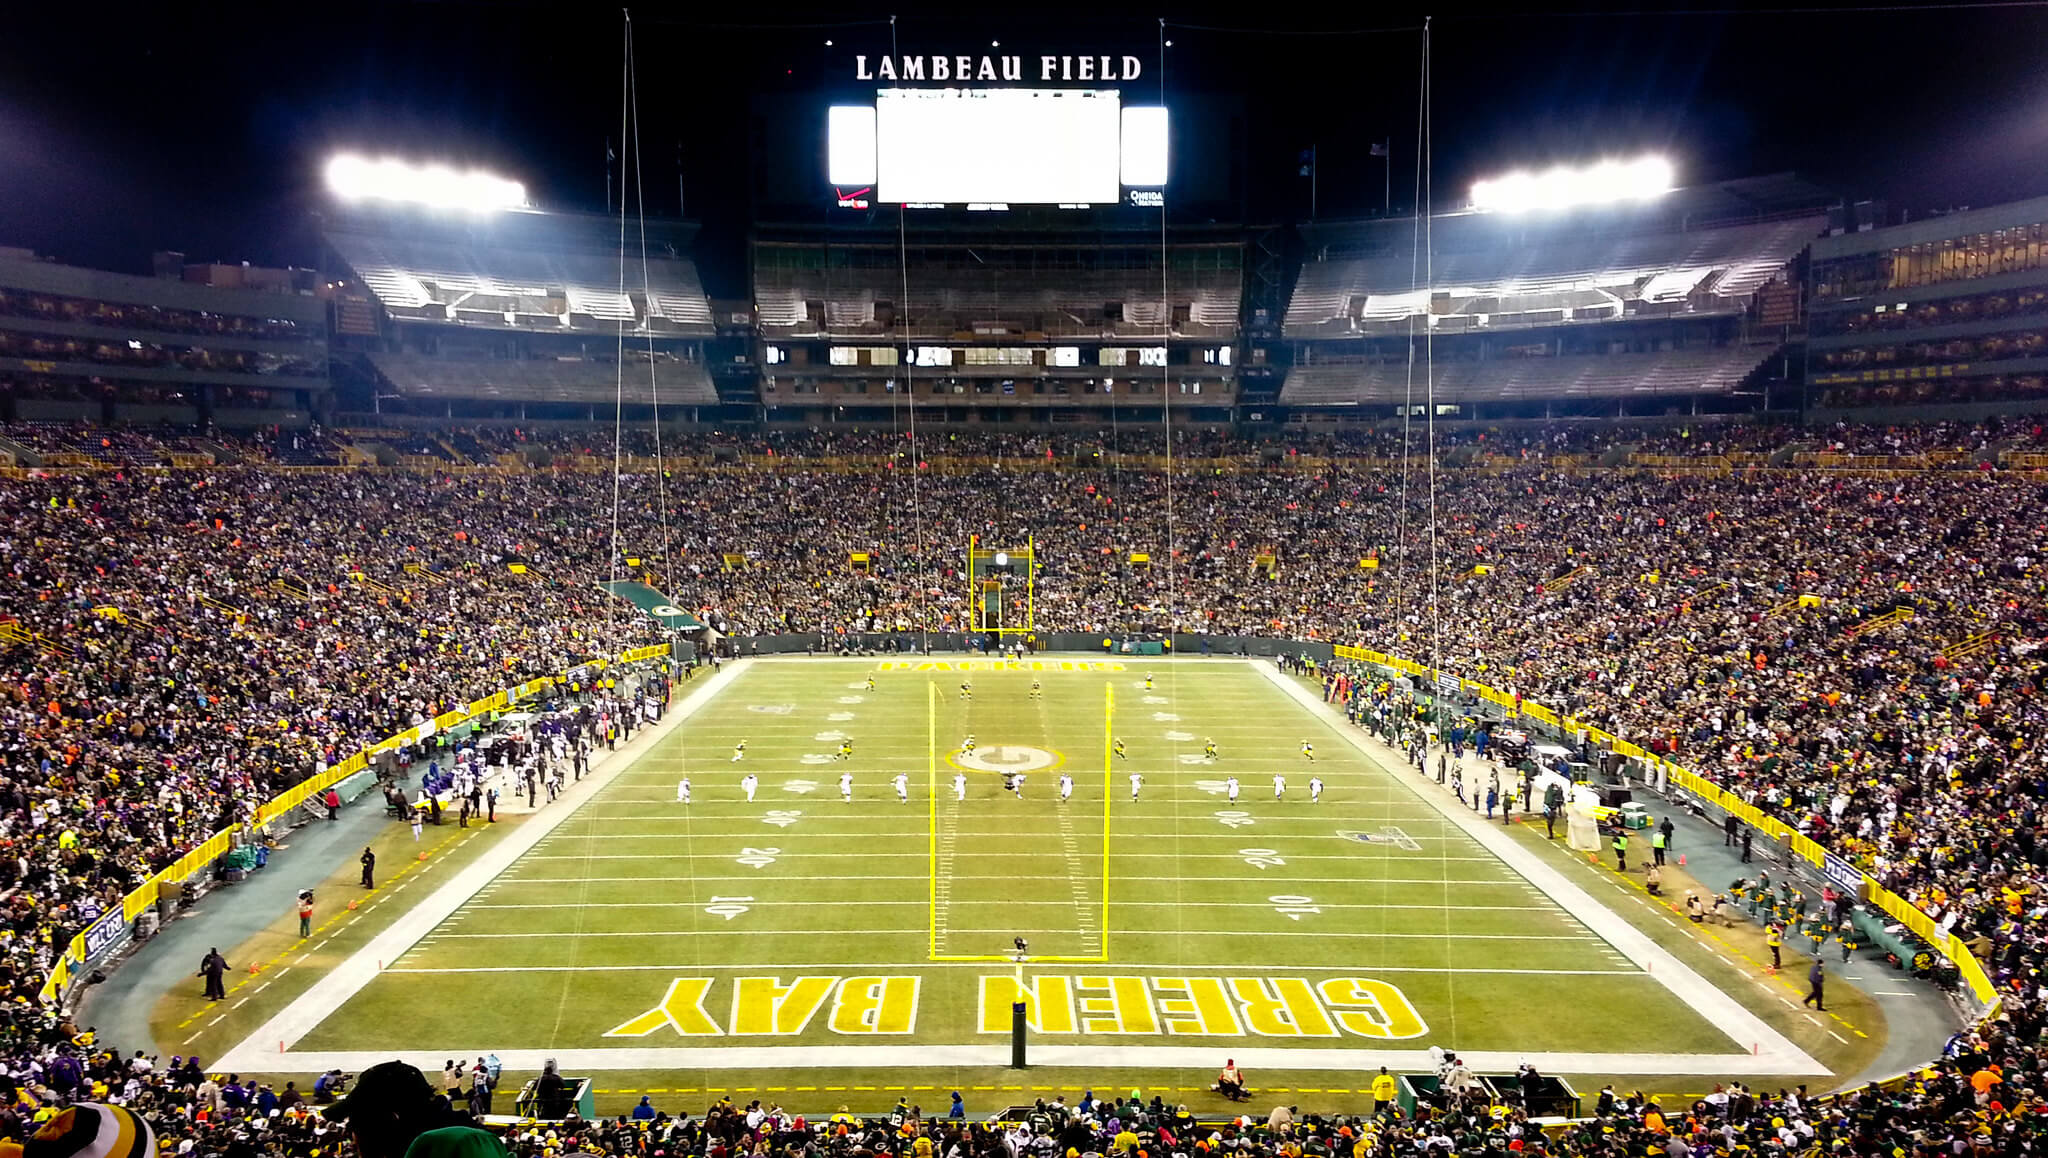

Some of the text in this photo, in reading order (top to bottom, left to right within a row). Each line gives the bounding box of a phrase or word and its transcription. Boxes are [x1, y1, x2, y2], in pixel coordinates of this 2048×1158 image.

[856, 55, 1142, 81] LAMBEAU FIELD
[735, 847, 781, 865] 20
[1238, 848, 1287, 866] 20
[704, 896, 755, 914] 10
[1268, 895, 1321, 914] 10
[602, 975, 1431, 1039] GREEN BAY
